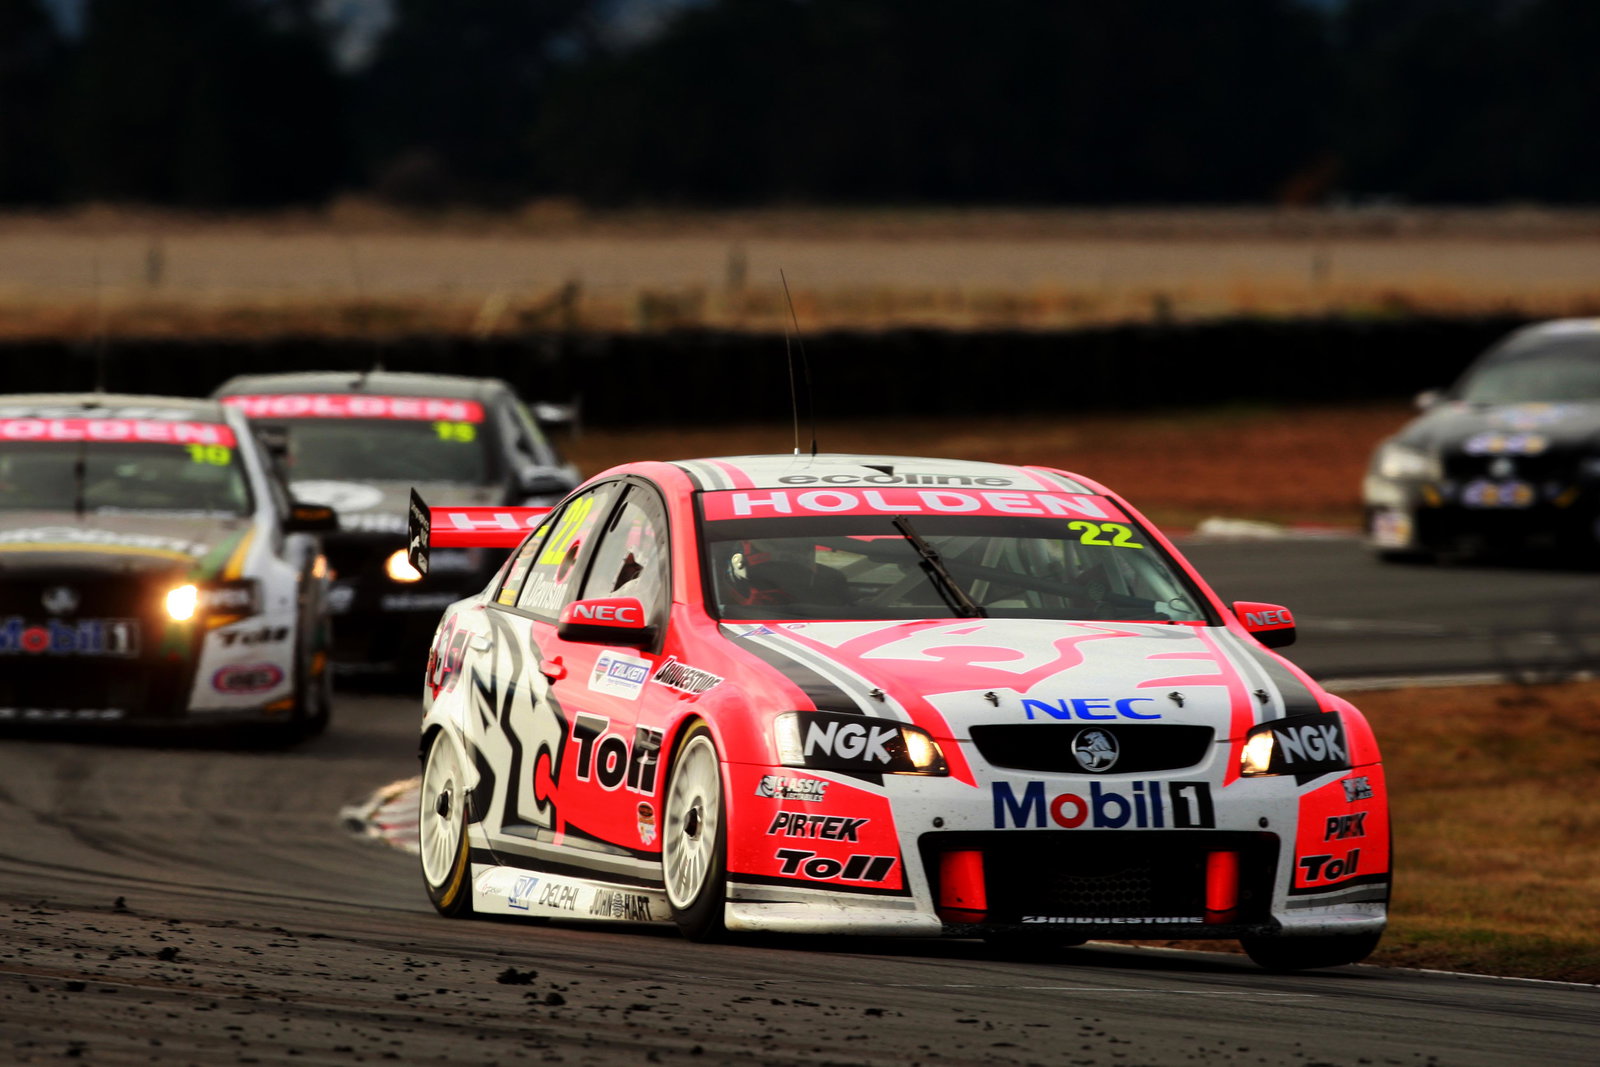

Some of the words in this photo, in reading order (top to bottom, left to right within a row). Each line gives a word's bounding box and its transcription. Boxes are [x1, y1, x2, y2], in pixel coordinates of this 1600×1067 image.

[433, 421, 476, 443] 15
[778, 473, 1013, 487] ecoline
[733, 489, 1109, 520] HOLDEN
[540, 497, 594, 565] 22
[1068, 521, 1144, 549] 22
[573, 604, 637, 623] NEC
[1245, 609, 1292, 626] NEC
[610, 662, 645, 682] FALKEN
[1021, 698, 1161, 720] NEC
[573, 712, 664, 797] Toll
[804, 721, 898, 764] NGK
[1274, 723, 1345, 764] NGK
[775, 775, 830, 795] CLASSIC
[992, 781, 1164, 829] Mobil
[768, 812, 869, 842] PIRTEK
[776, 849, 896, 882] Toll
[1299, 848, 1360, 883] Toll
[538, 883, 580, 911] DELPHI
[589, 888, 614, 917] JOHN
[624, 893, 652, 920] HART
[1021, 915, 1205, 925] BRIDGESTONE
